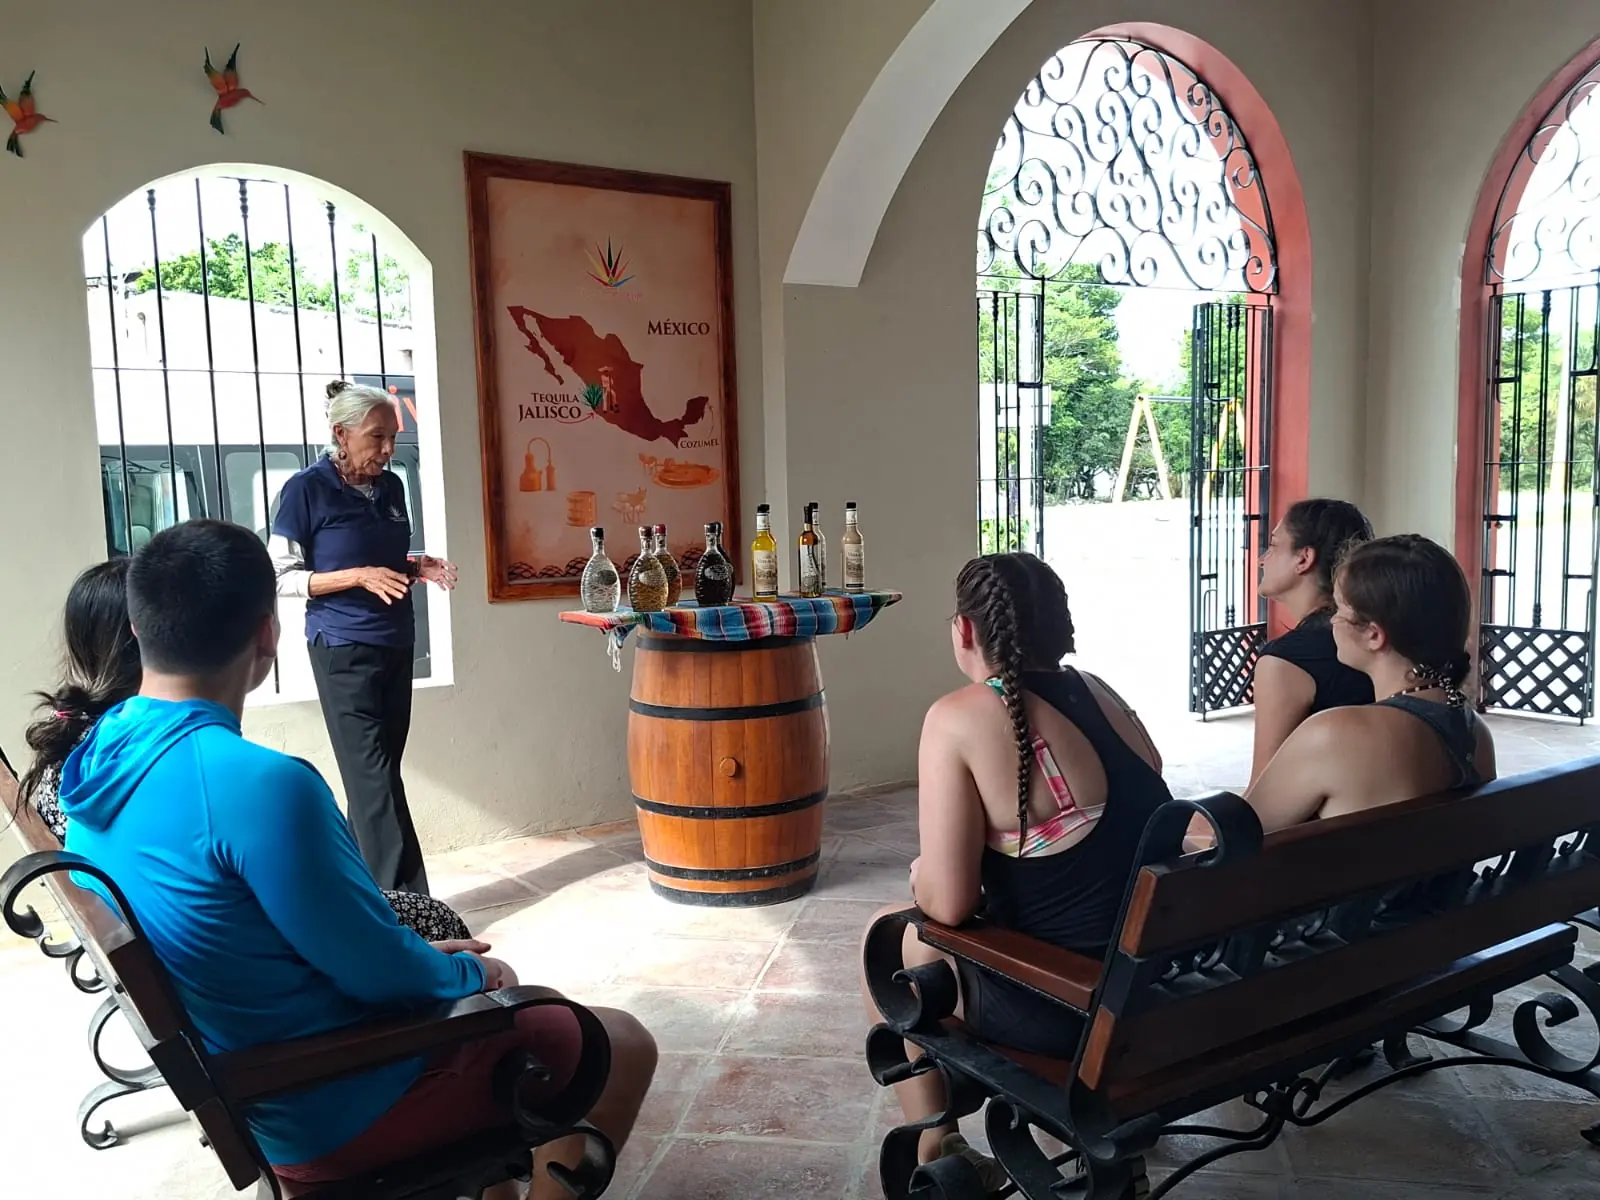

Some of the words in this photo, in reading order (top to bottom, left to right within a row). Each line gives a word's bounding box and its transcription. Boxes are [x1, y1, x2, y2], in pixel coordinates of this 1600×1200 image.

[647, 318, 710, 336] MÉXICO
[531, 392, 580, 405] TEQUILA
[518, 404, 581, 422] JALISCO
[680, 439, 720, 449] COZUMEL
